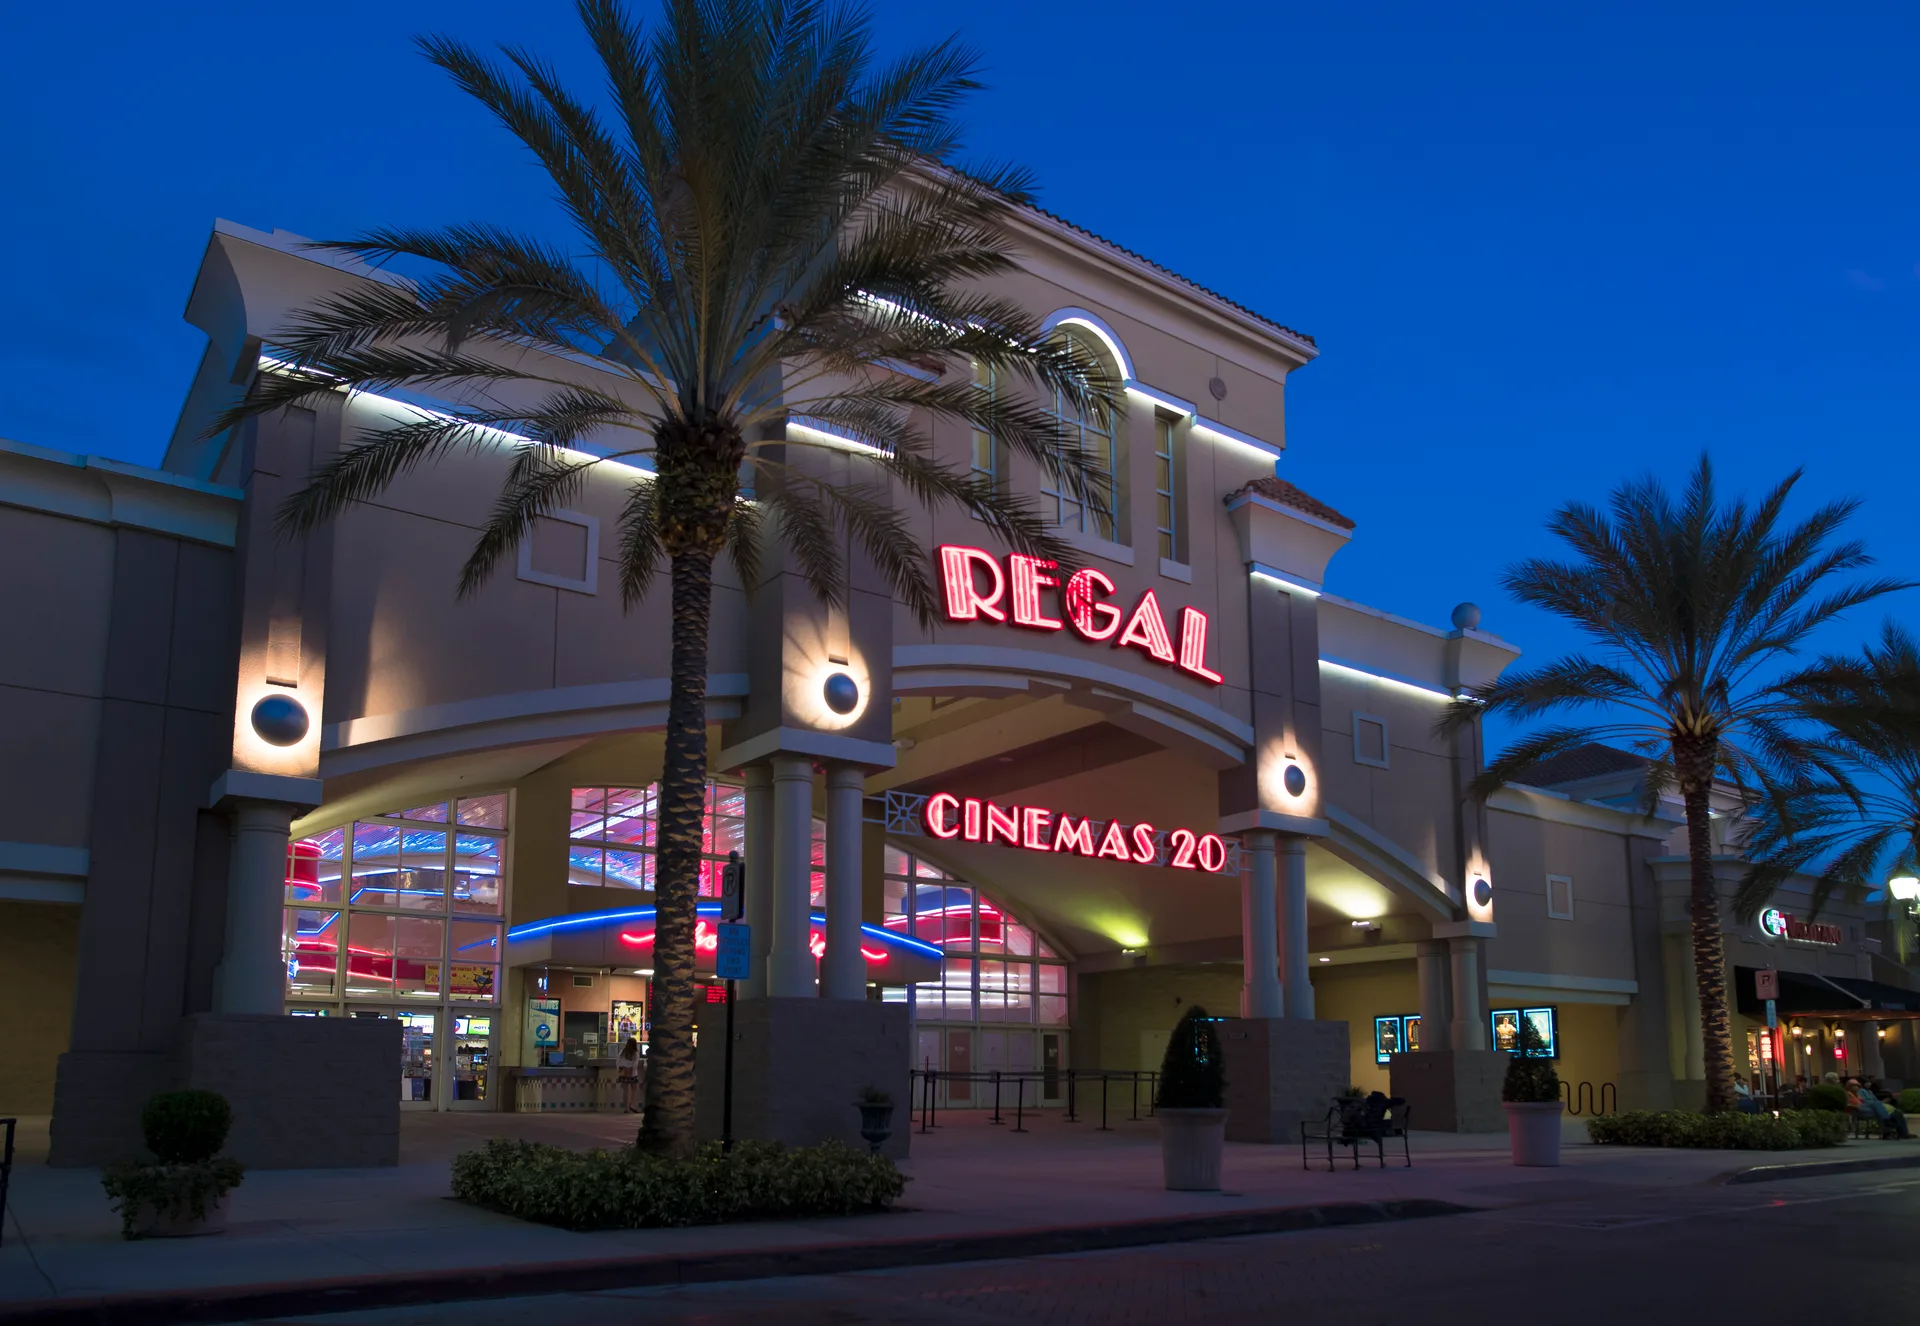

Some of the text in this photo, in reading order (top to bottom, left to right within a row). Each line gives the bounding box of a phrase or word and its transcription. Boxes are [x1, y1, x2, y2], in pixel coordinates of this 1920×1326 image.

[935, 544, 1224, 685] REGAL
[923, 792, 1226, 872] CINEMAS 20
